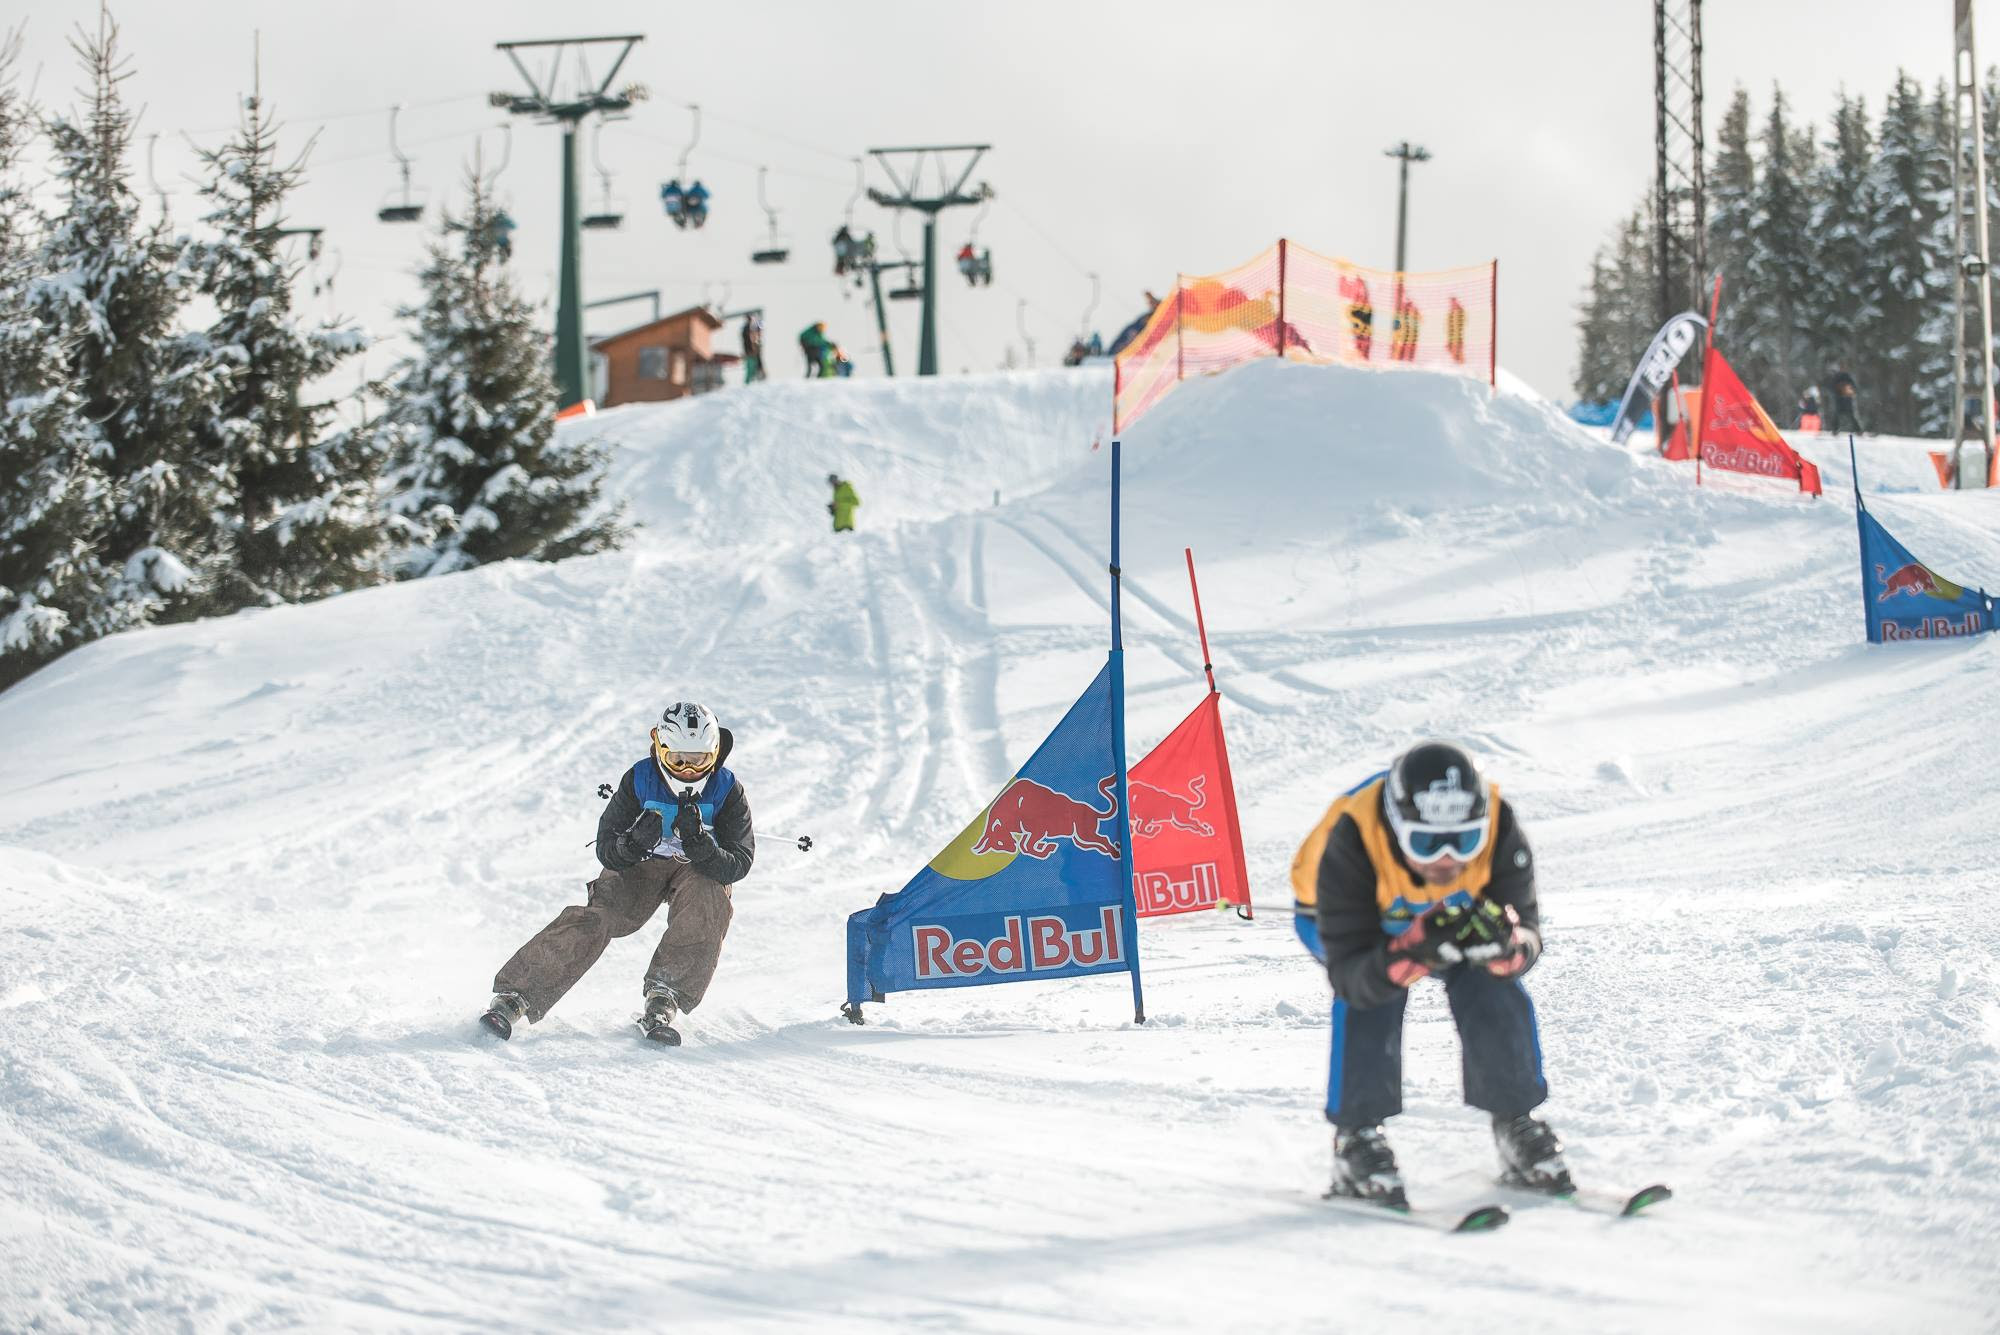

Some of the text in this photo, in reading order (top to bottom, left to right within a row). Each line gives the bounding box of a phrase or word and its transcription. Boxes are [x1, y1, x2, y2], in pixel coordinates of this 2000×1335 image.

[1702, 442, 1745, 469] Red
[1881, 612, 1980, 641] Red Bull
[1143, 862, 1220, 912] Bull
[912, 915, 1026, 979] Red
